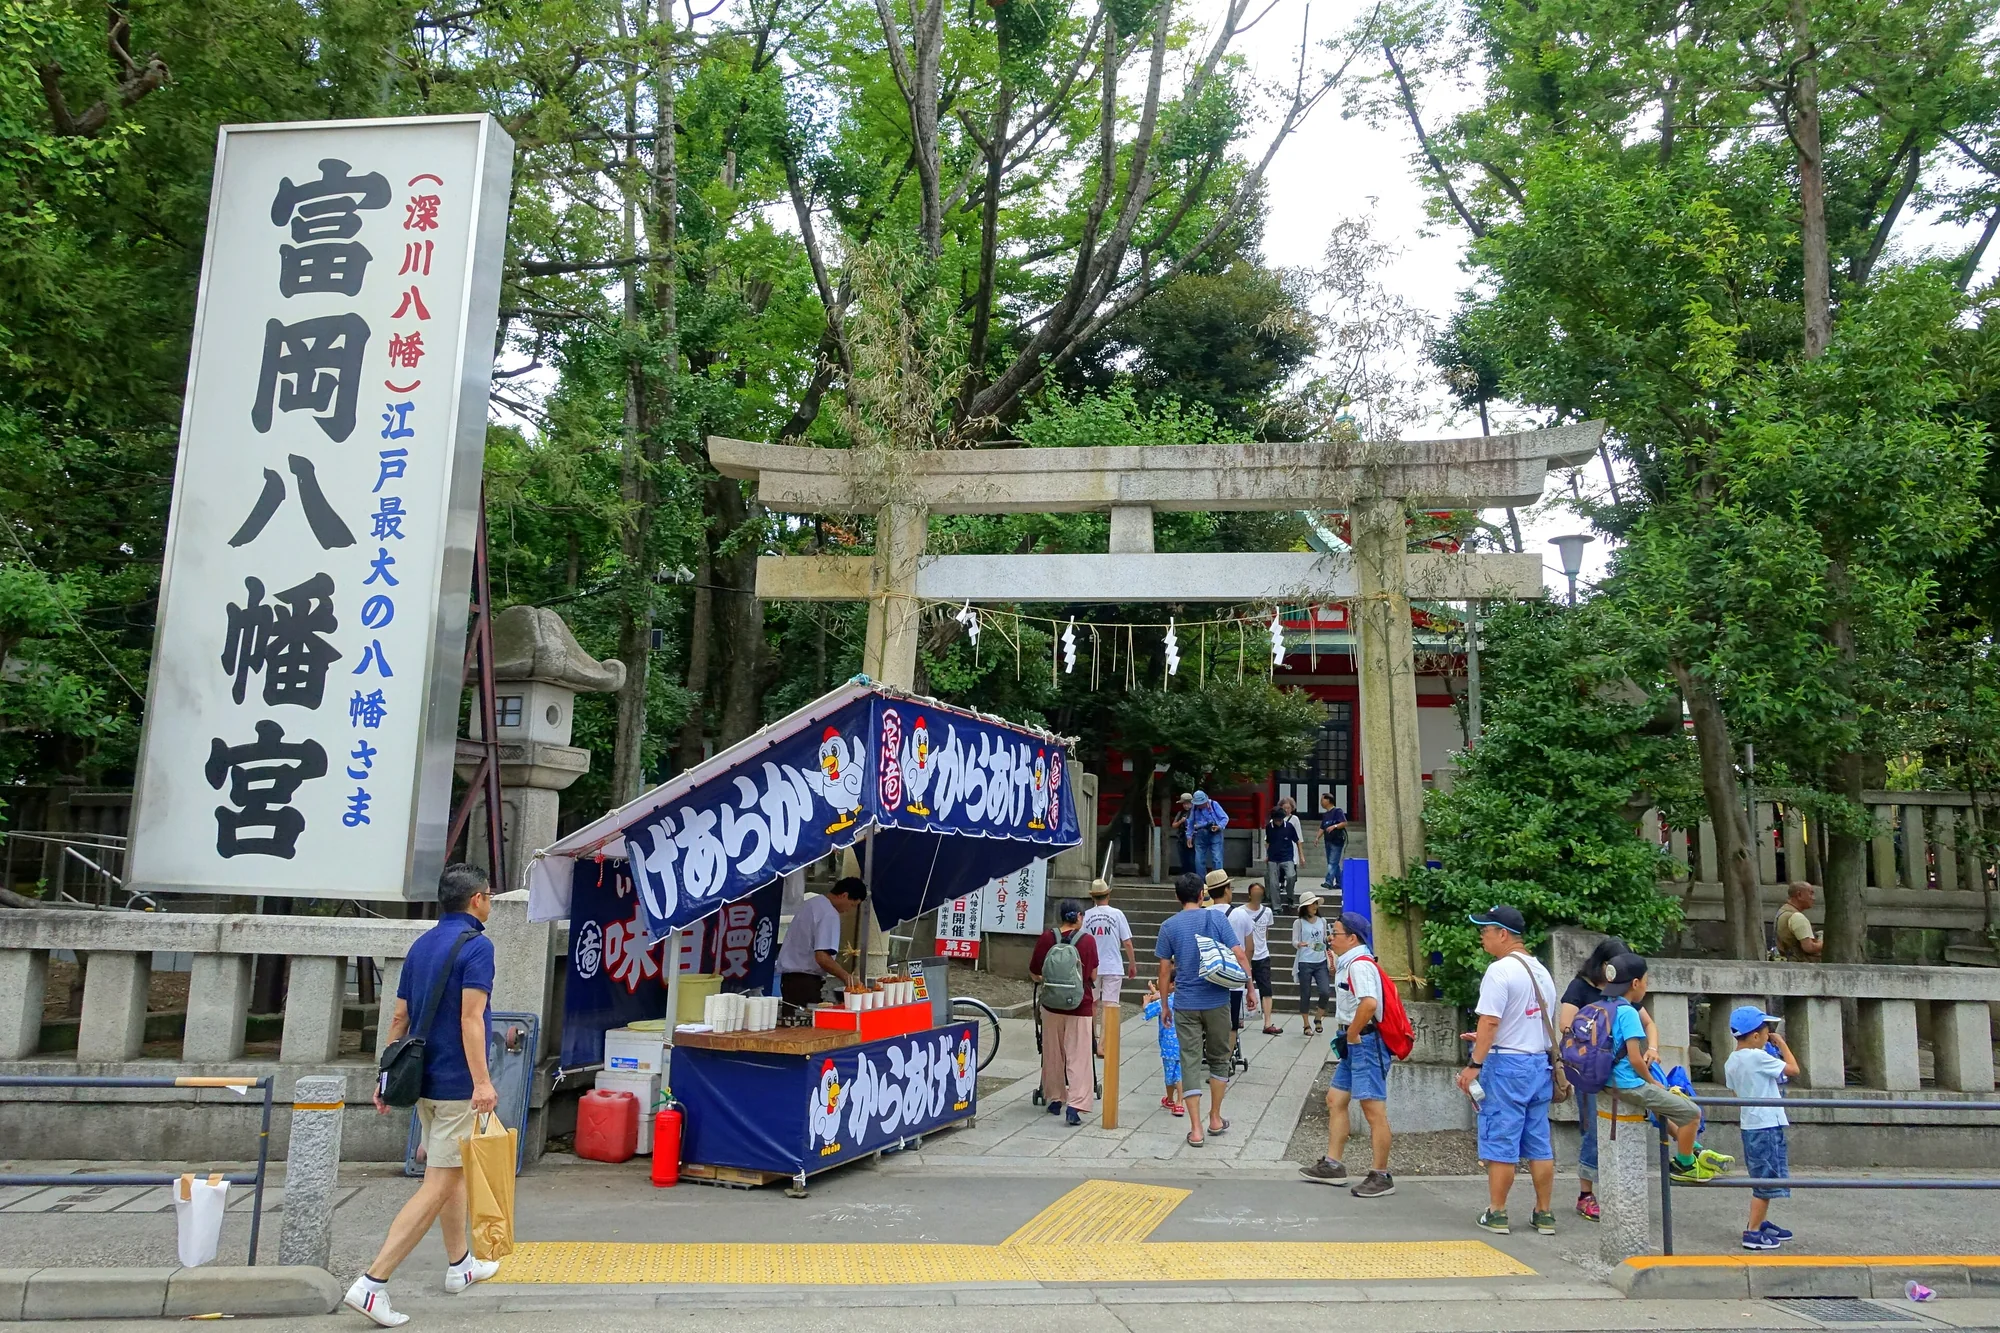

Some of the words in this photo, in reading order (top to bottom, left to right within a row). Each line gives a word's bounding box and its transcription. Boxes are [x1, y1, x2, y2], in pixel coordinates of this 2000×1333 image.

[205, 158, 392, 859] 富岡八幡宮
[933, 723, 1032, 828] からあげ
[952, 897, 967, 938] 日開催
[968, 890, 980, 938] 八幡宮骨董市
[1090, 926, 1111, 936] VAN
[848, 1034, 953, 1146] からあげ
